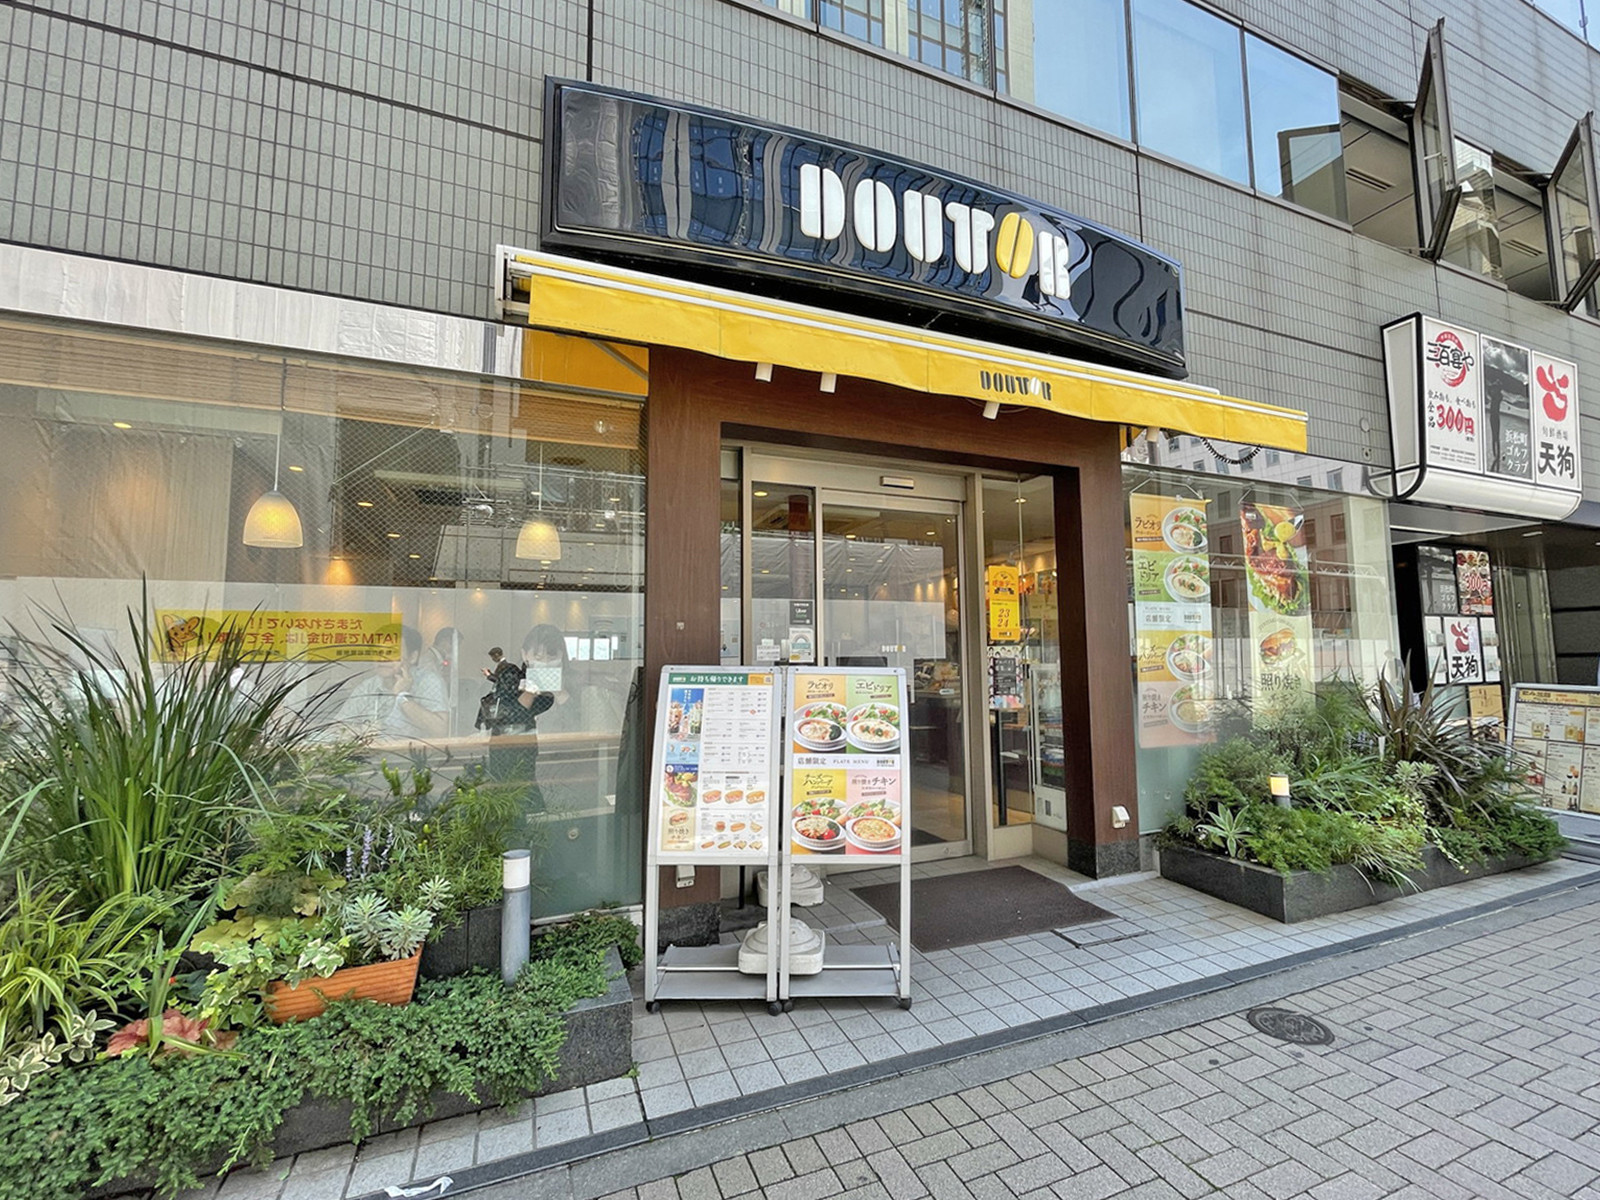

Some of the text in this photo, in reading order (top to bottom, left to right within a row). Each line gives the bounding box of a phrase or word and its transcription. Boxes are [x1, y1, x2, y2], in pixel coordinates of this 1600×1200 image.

[800, 163, 1071, 300] DOUTOR
[980, 370, 1051, 401] DOUTOR
[1437, 404, 1475, 436] 300円
[1505, 429, 1528, 446] 浜松町
[1506, 445, 1528, 459] ゴルフ
[1538, 441, 1575, 480] 天狗
[1507, 459, 1529, 473] クラブ
[1138, 560, 1157, 571] エビ
[1140, 571, 1159, 582] ドリア
[1451, 655, 1479, 678] 天狗
